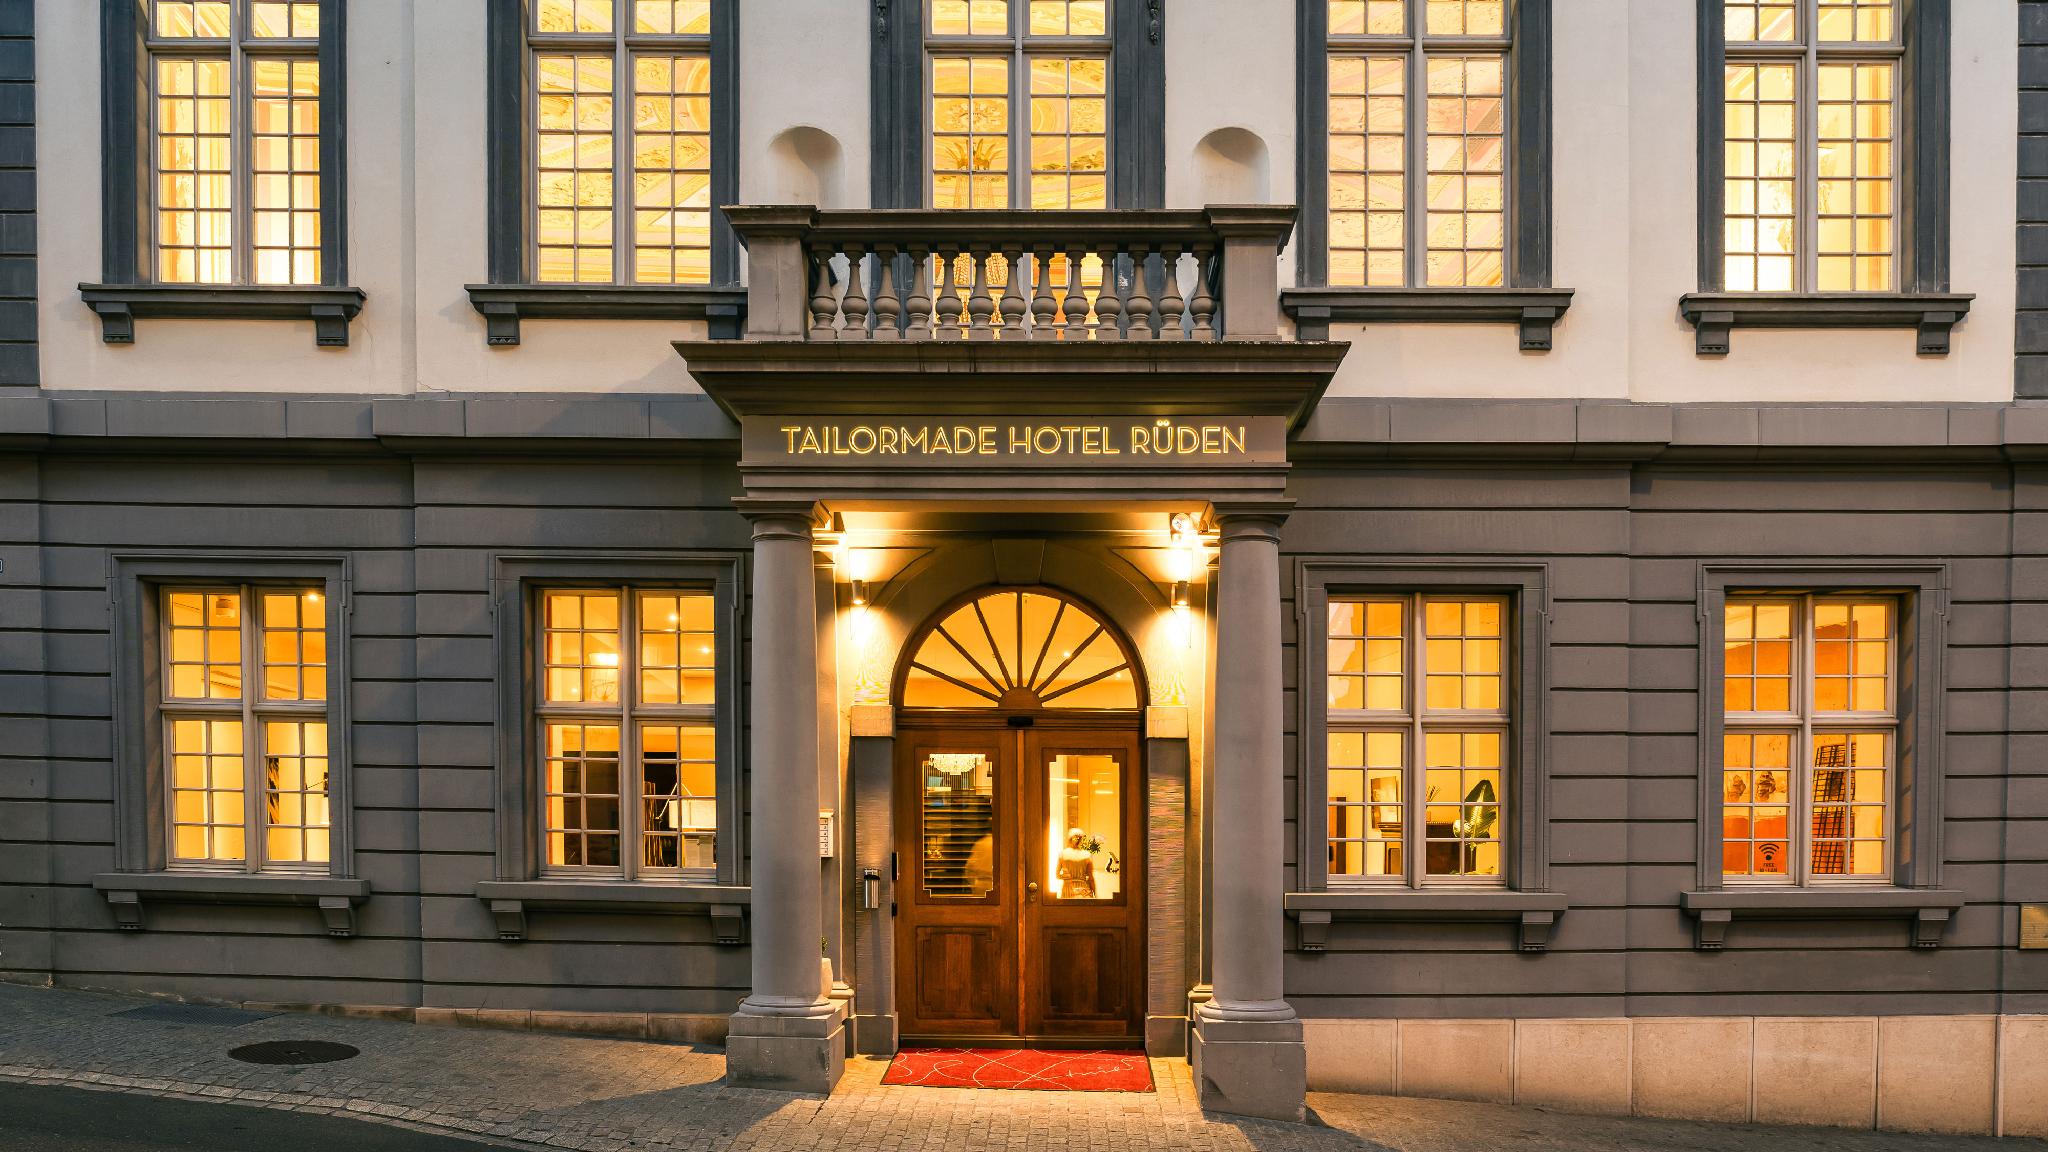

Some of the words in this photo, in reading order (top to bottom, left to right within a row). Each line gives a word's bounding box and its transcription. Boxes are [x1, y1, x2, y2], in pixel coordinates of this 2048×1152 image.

[780, 426, 998, 454] TAILORMADE
[1009, 426, 1120, 454] HOTEL
[1131, 419, 1246, 454] RÜDEN
